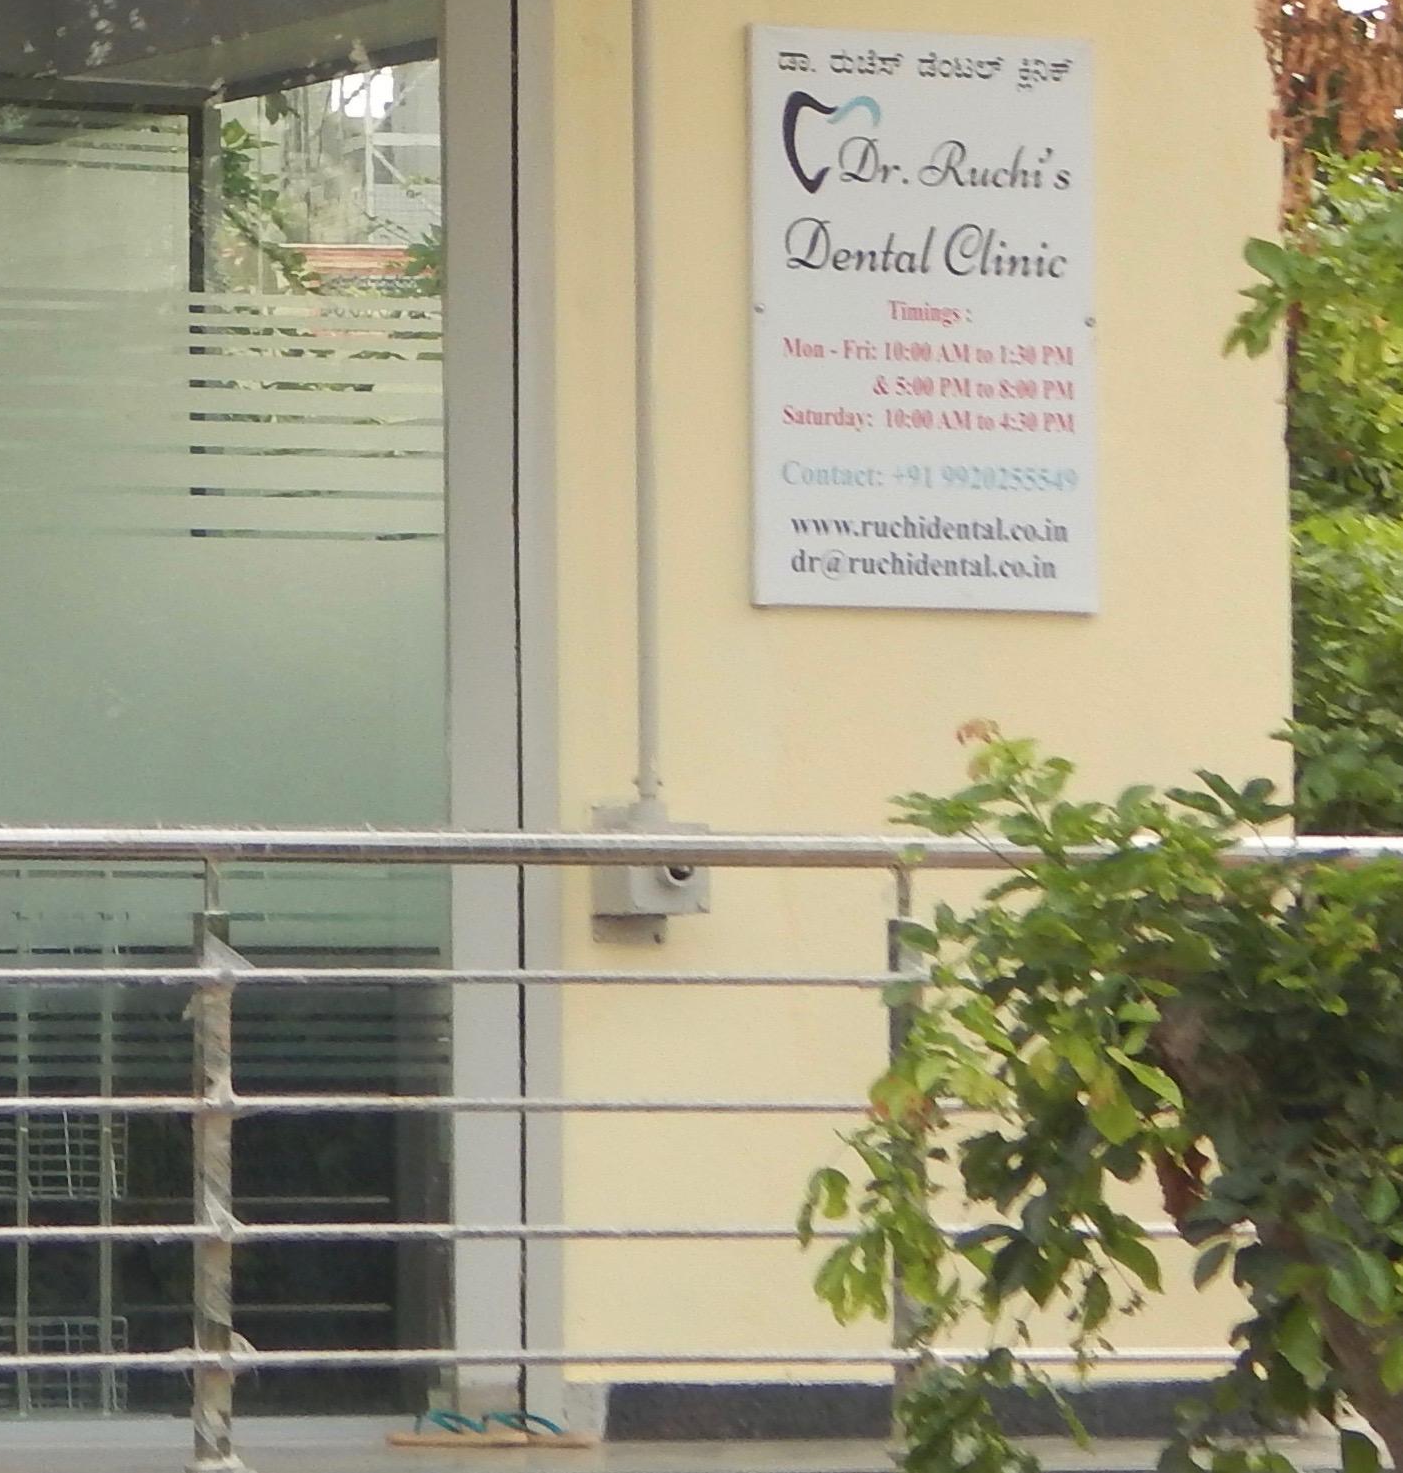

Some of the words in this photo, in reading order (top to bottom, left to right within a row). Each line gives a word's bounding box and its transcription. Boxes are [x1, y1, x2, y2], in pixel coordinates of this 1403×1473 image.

[839, 137, 908, 184] Dr.
[919, 140, 1070, 190] Ruchi's
[785, 218, 935, 273] Dental
[945, 224, 1066, 278] Clinic
[784, 337, 824, 358] Mon
[844, 340, 876, 360] Fri:
[885, 342, 932, 362] 10:00
[938, 343, 969, 363] AM
[976, 348, 993, 363] to
[1000, 344, 1036, 365] 1:30
[1043, 346, 1073, 366] PM
[873, 376, 889, 395] &
[896, 376, 934, 396] 5:00
[940, 377, 970, 397] PM
[976, 383, 994, 398] to
[1000, 380, 1037, 399] 8:00
[1043, 380, 1073, 400] PM
[783, 405, 873, 432] Saturday:
[886, 408, 933, 429] 10:00
[938, 411, 971, 430] AM
[977, 415, 995, 431] to
[999, 412, 1038, 432] 4:30
[1044, 413, 1074, 432] PM
[781, 460, 883, 487] Contact:
[893, 465, 932, 488] +91
[791, 515, 1067, 542] www.ruchidental.co.in
[791, 549, 1056, 579] dr@ruchidental.co.in
